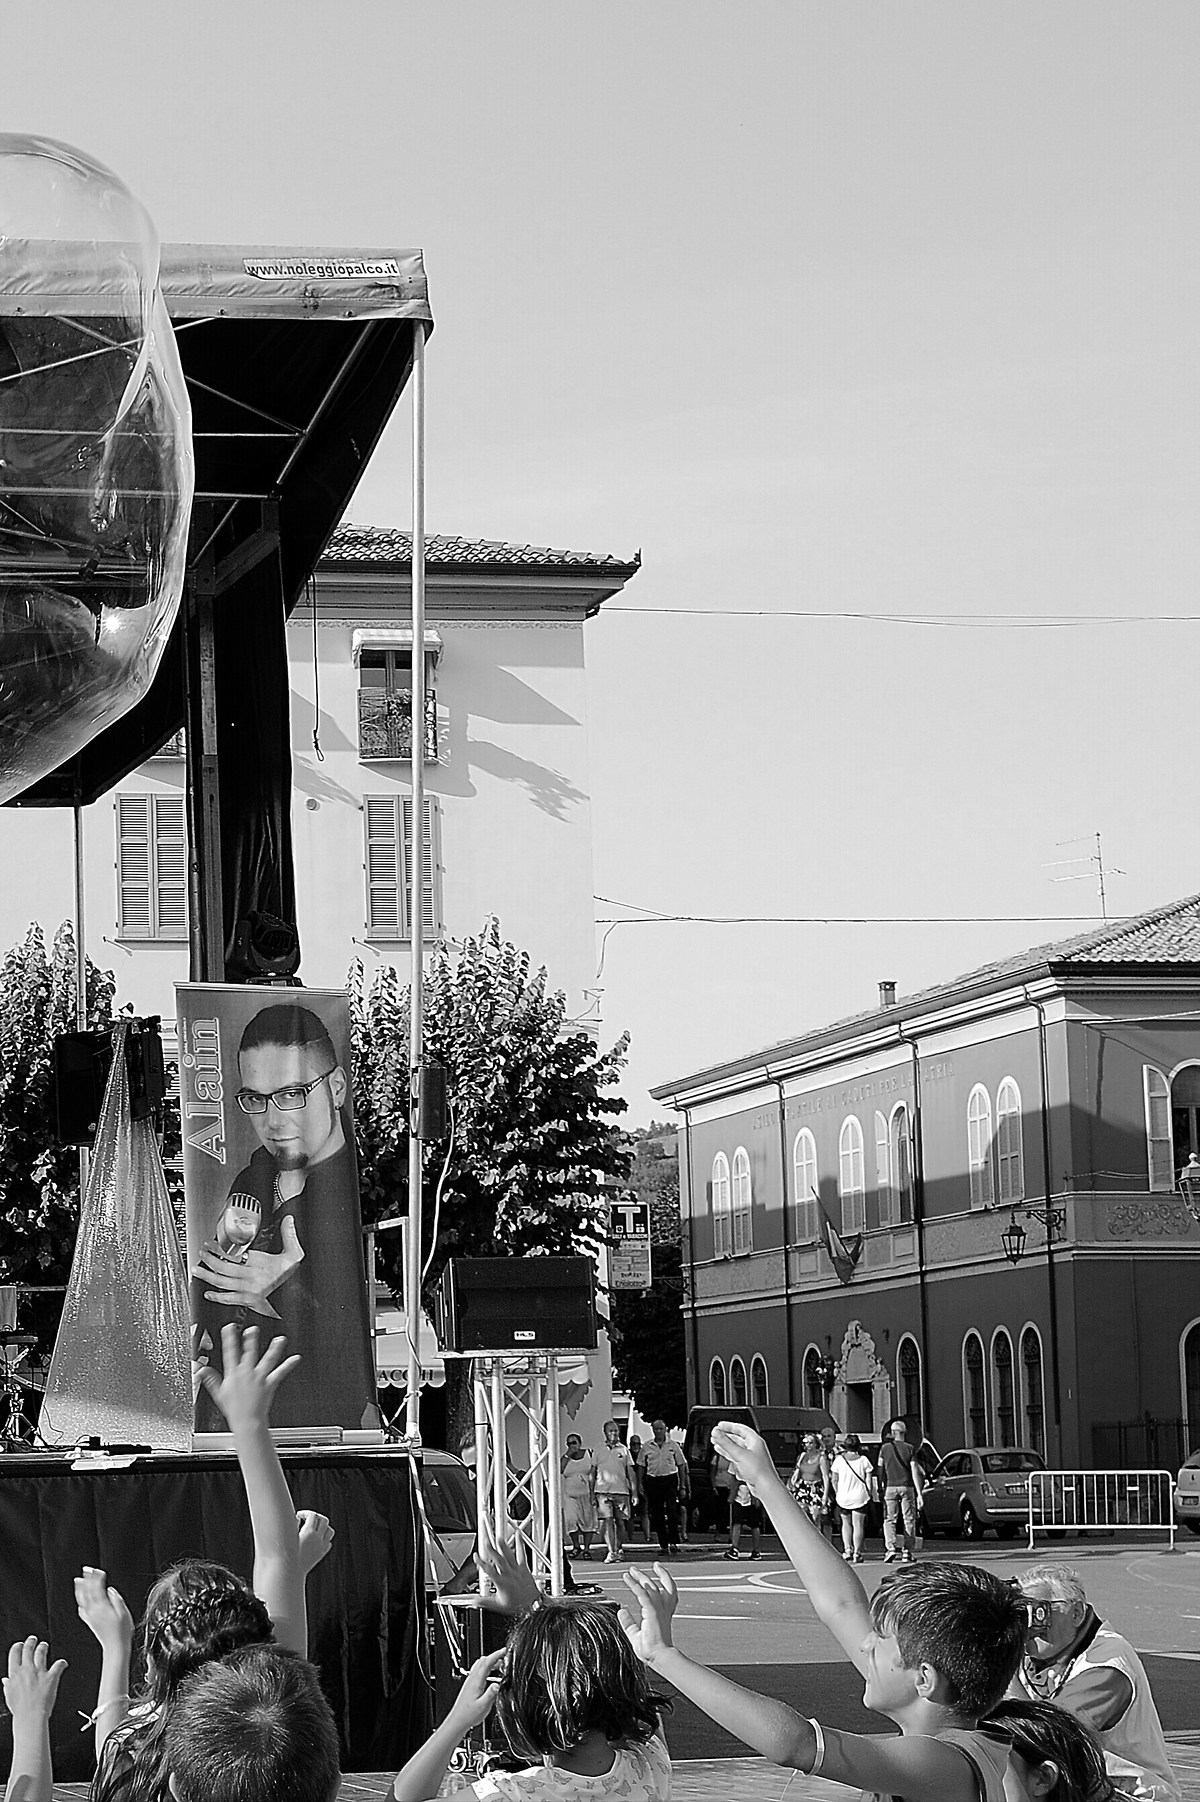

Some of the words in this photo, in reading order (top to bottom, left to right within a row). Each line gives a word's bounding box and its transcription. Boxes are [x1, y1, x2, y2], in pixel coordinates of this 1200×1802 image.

[247, 262, 398, 277] www.noleggiopalco.it
[923, 1062, 955, 1082] ATRIA
[183, 1017, 226, 1164] Alain
